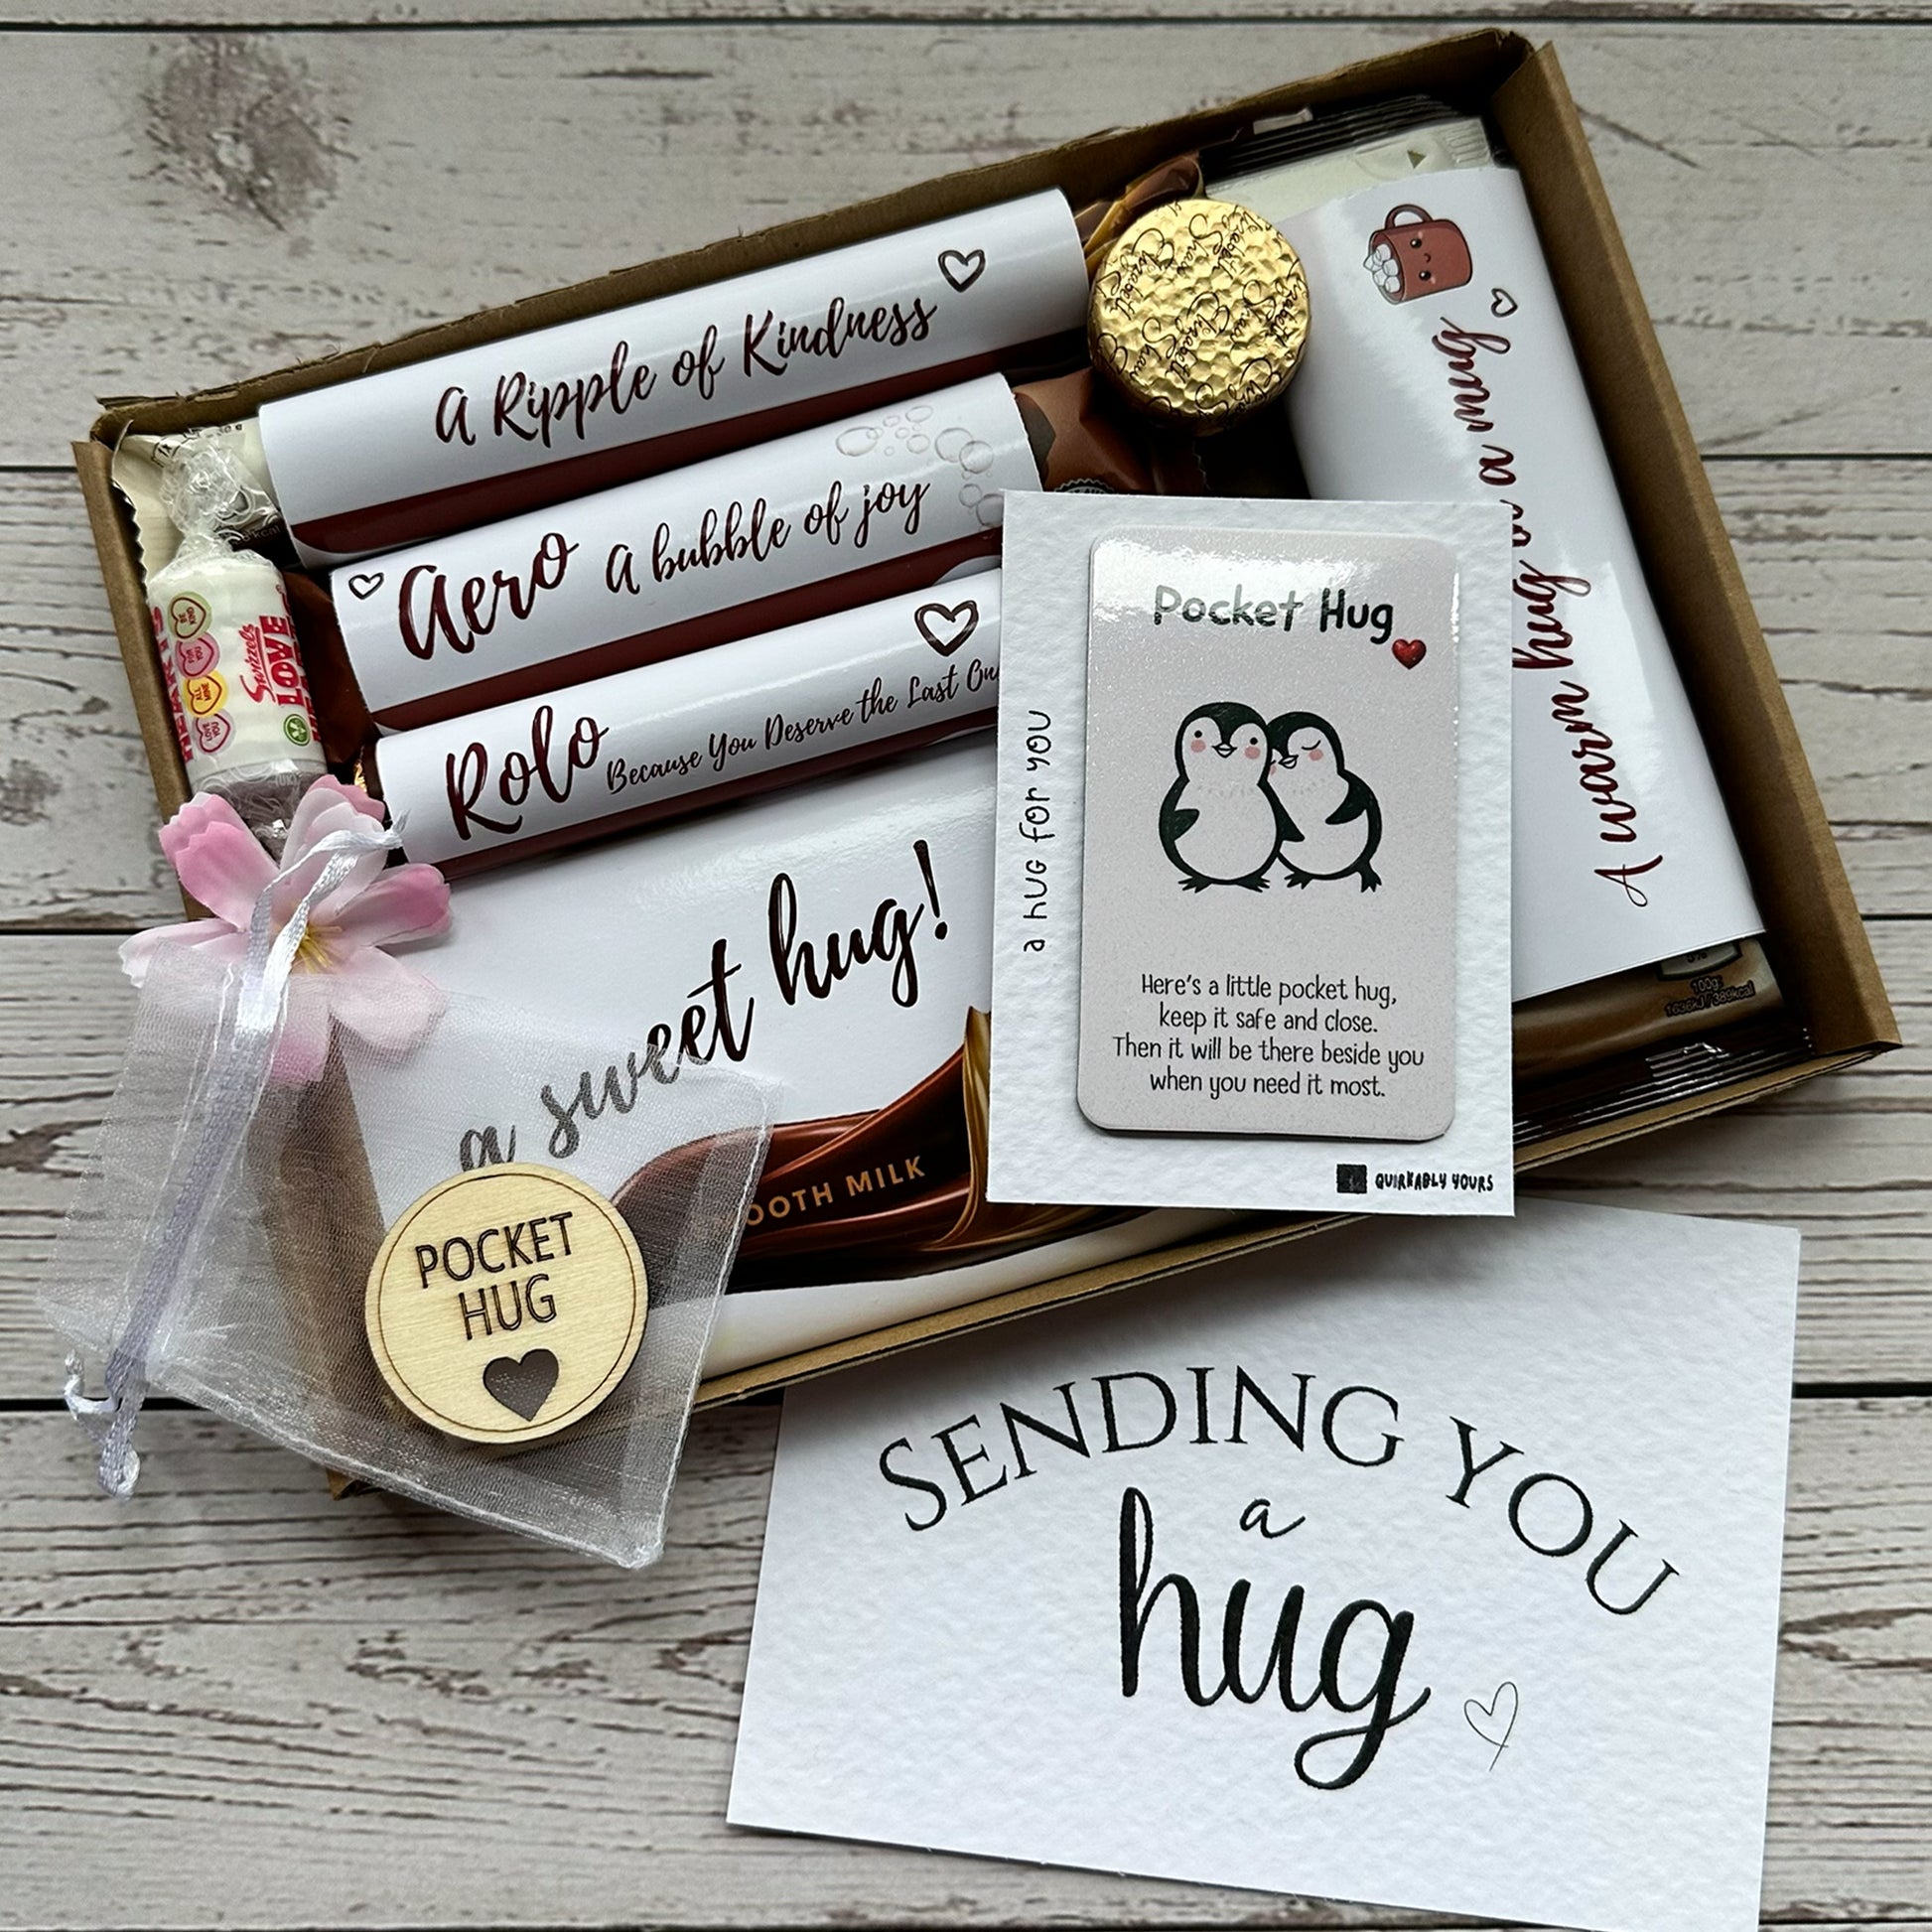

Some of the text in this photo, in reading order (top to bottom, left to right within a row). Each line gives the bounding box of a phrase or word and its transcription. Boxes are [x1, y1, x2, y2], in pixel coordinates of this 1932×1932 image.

[1110, 227, 1175, 321] Elizabeth
[1230, 279, 1277, 343] Shaw
[435, 296, 939, 449] A Ripple of Kindness
[1129, 317, 1176, 381] Shaw
[1165, 291, 1230, 383] Elizabeth
[1431, 316, 1512, 432] mug
[605, 480, 932, 595] A bubble of joy
[398, 531, 580, 661] Aero
[1154, 584, 1394, 644] Pocket Hug
[1512, 559, 1591, 669] hug
[239, 622, 277, 704] Swizzels
[259, 615, 305, 706] LOVE
[607, 750, 704, 795] Because
[708, 731, 757, 773] You
[764, 706, 856, 746] Deserve
[857, 676, 898, 715] the
[907, 663, 960, 709] Last
[1552, 680, 1638, 844] warm
[445, 705, 610, 842] Rolo
[1594, 854, 1663, 907] A
[1023, 938, 1046, 953] a
[540, 938, 755, 1160] sweet
[767, 839, 950, 1008] hug!
[1142, 973, 1397, 1010] Here's a little pocket hug,
[1160, 1002, 1378, 1035] keep it safe and close.
[1112, 1032, 1425, 1074] Then it will be there beside you
[1150, 1065, 1386, 1100] when you need it most.
[846, 1156, 926, 1197] MILK
[1375, 1171, 1494, 1192] QUIRKABLY YOURS
[415, 1211, 573, 1290] POCKET
[458, 1273, 557, 1340] HUG
[879, 1364, 1681, 1617] SENDING YOU
[1238, 1497, 1307, 1540] a
[1118, 1485, 1432, 1791] hug
